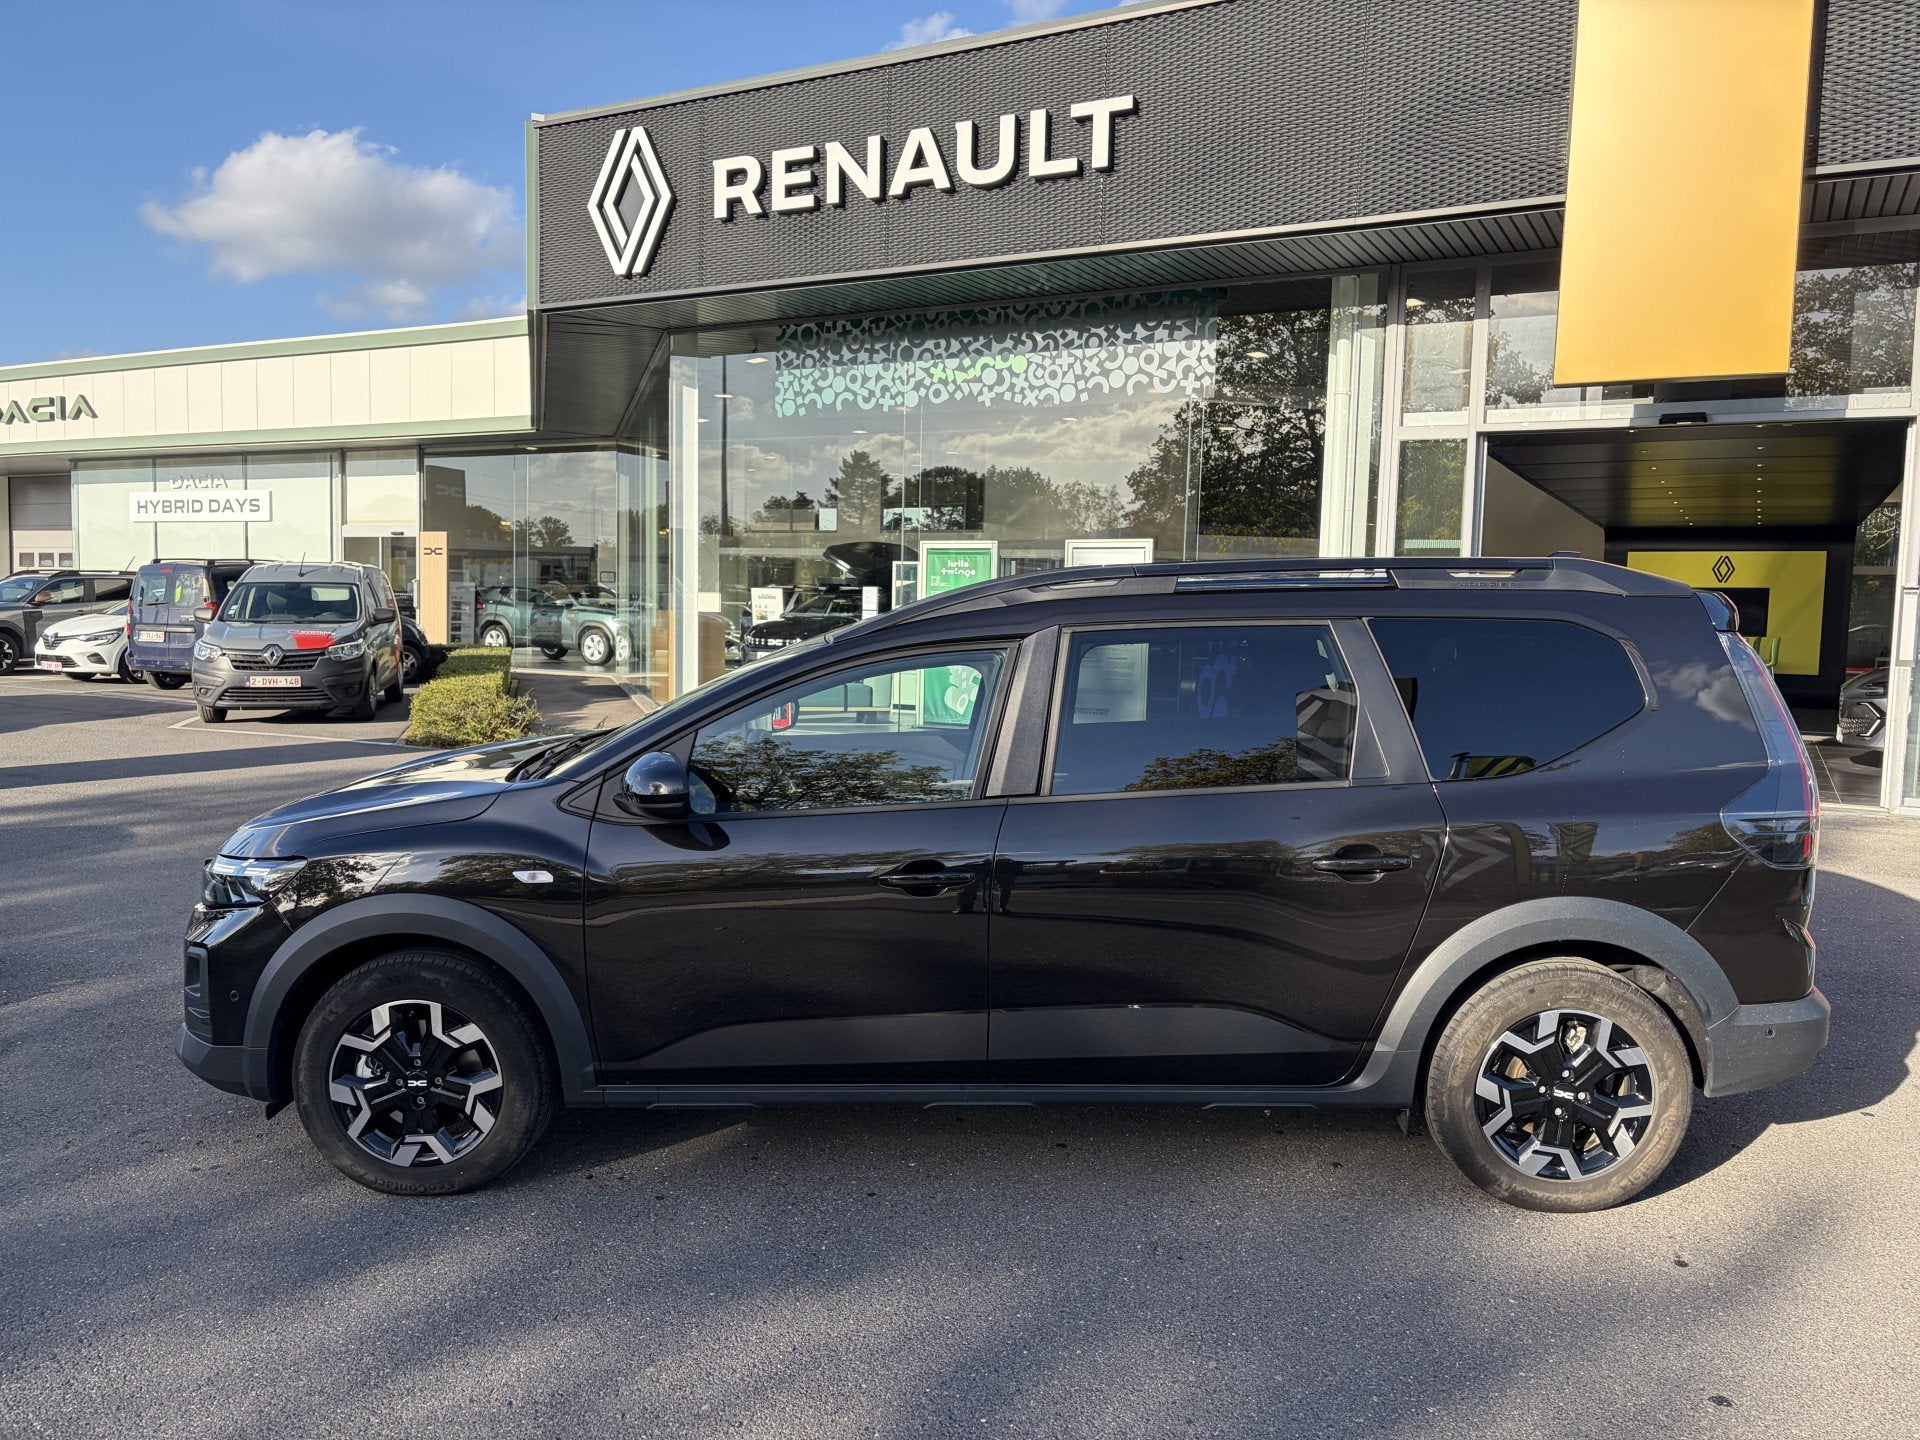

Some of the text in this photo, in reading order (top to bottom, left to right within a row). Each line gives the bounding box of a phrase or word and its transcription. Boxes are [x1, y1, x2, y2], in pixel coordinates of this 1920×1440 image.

[713, 94, 1139, 220] RENAULT
[0, 394, 98, 425] ACIA
[137, 498, 261, 514] HYBRID DAYS
[947, 559, 970, 568] hello
